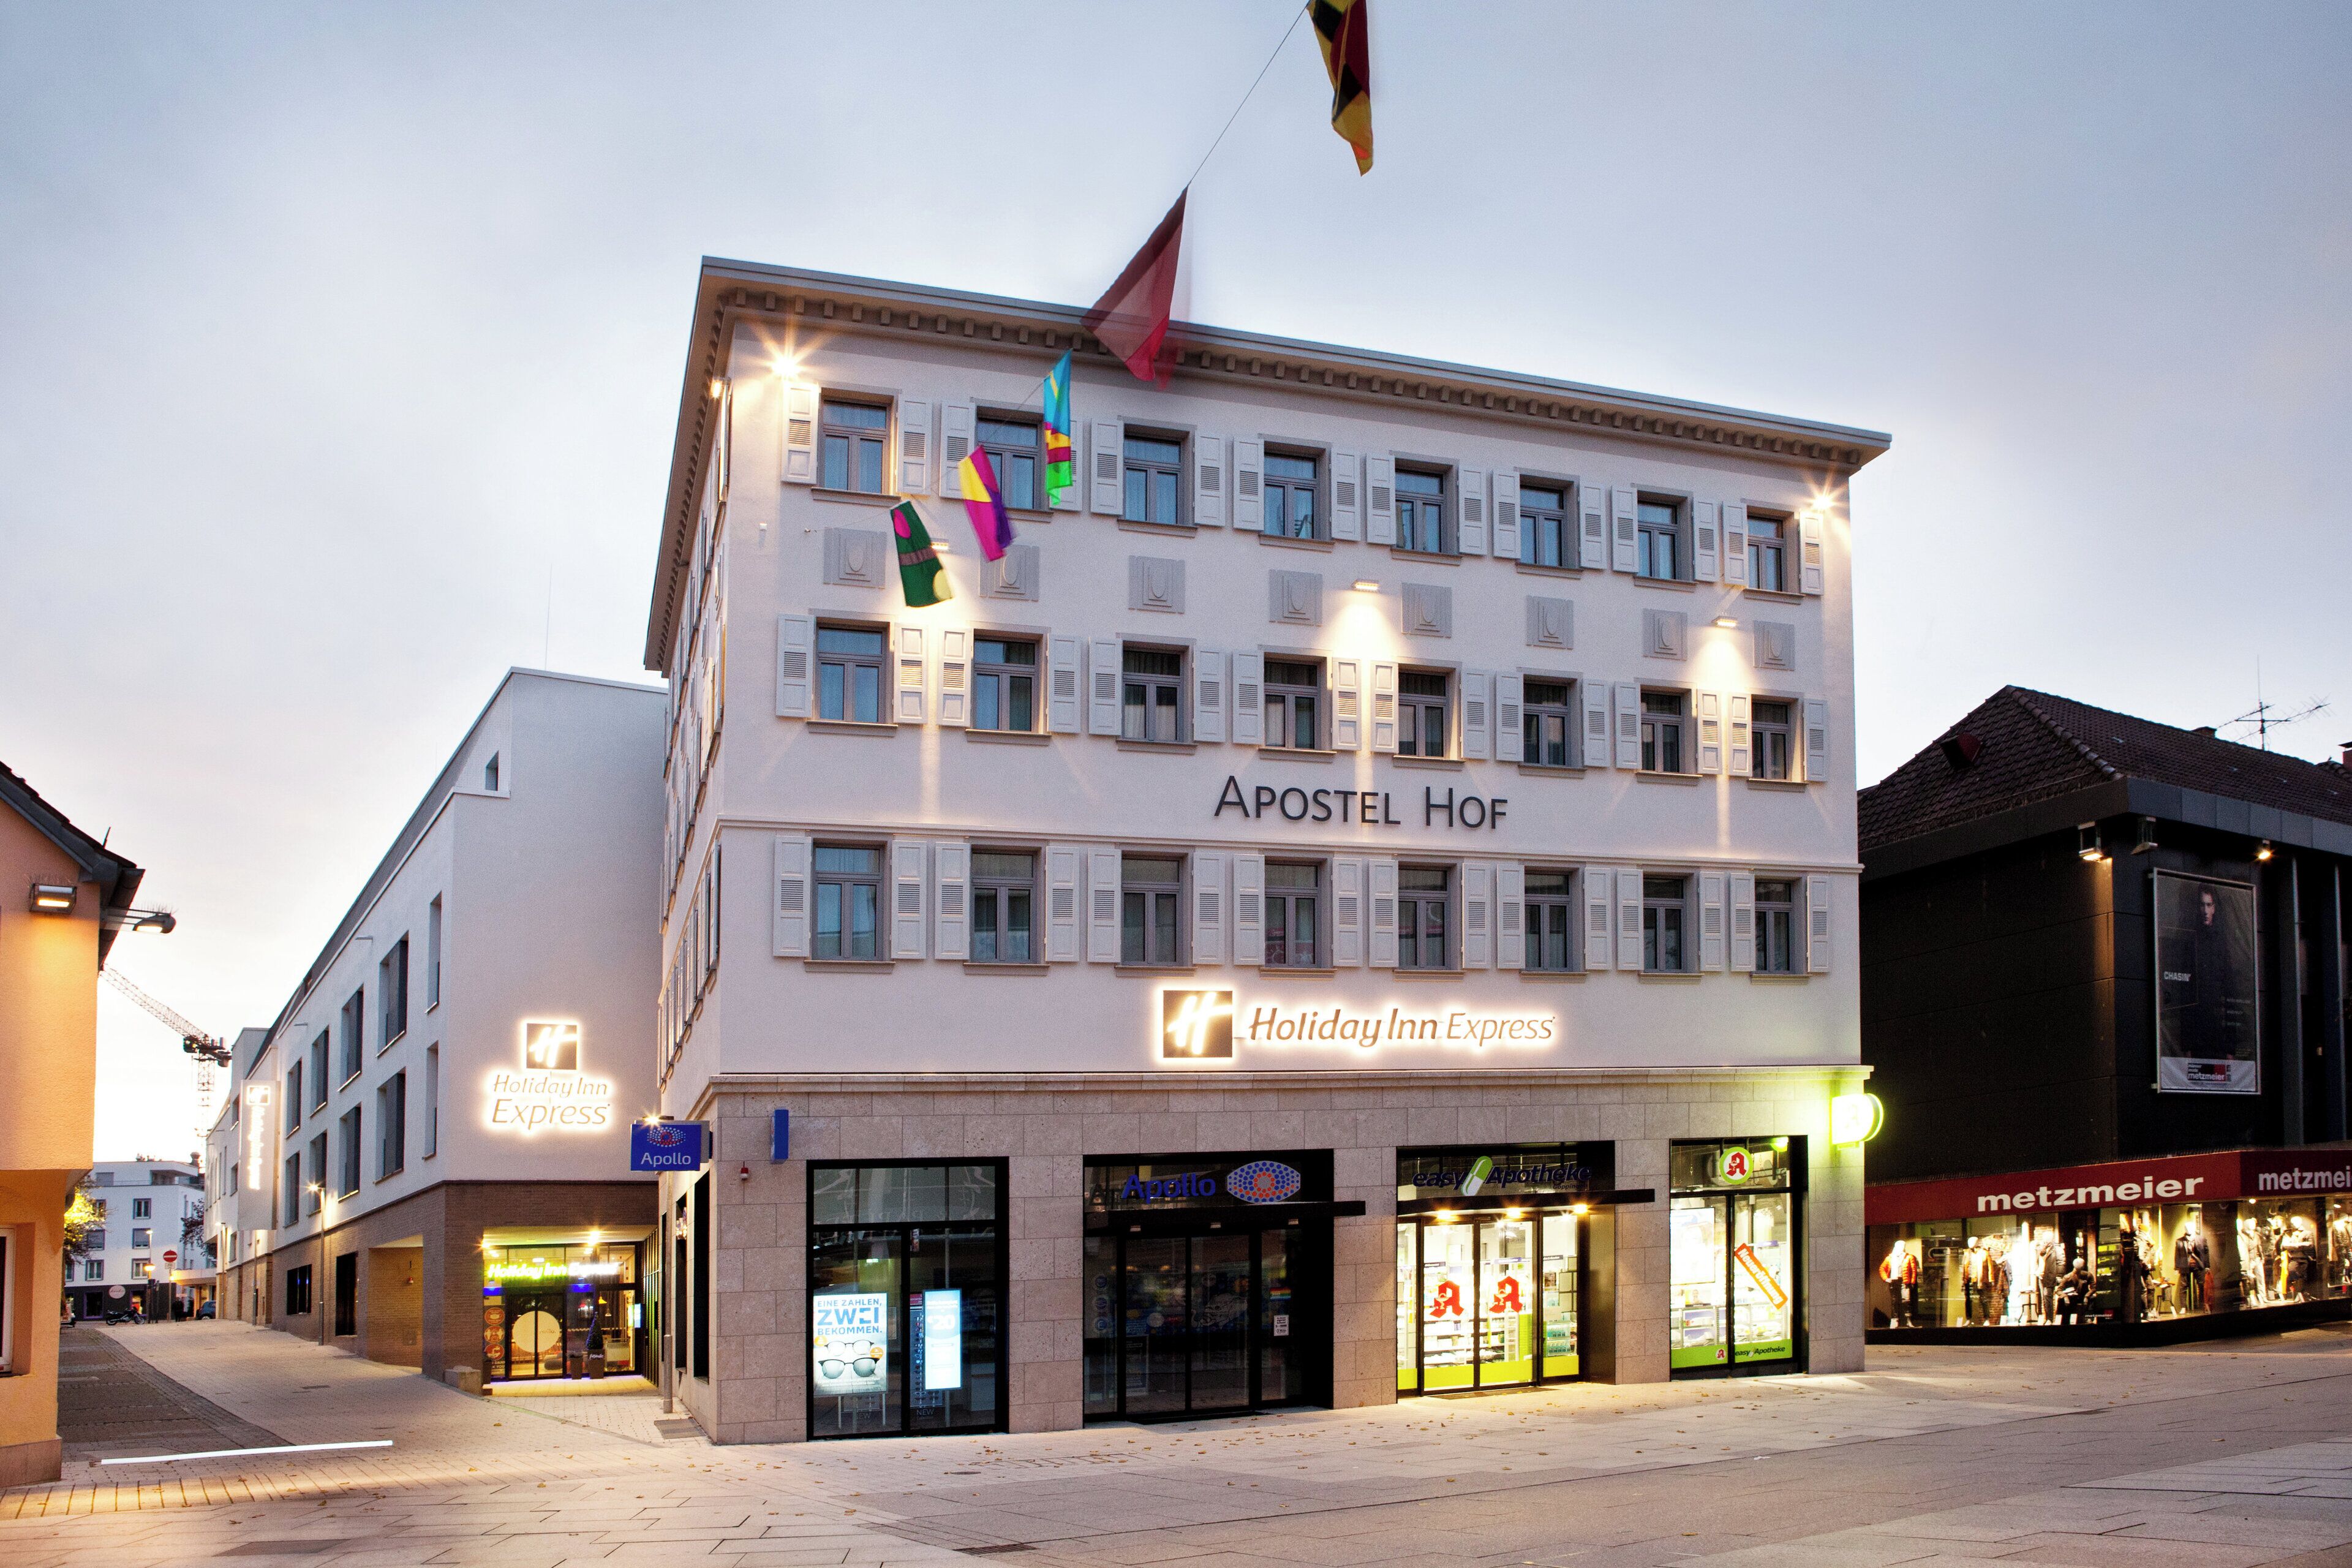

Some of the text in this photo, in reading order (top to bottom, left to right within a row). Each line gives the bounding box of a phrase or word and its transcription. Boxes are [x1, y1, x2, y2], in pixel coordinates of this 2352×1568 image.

[1214, 775, 1508, 829] APOSTEL HOF
[1250, 1008, 1553, 1048] Holiday Inn Express
[494, 1075, 607, 1098] Holiday Inn
[492, 1099, 607, 1130] Express
[641, 1153, 691, 1167] Apollo
[1121, 1172, 1216, 1204] Apollo
[1412, 1164, 1592, 1190] easy Apotheke
[2259, 1166, 2352, 1190] metzmei
[1978, 1175, 2204, 1212] metzmeier
[488, 1264, 543, 1279] Holiday
[545, 1263, 568, 1276] Inn
[817, 1307, 879, 1325] ZWEI
[818, 1326, 883, 1335] BEKOMMEN.
[1755, 1346, 1785, 1355] Apotheke
